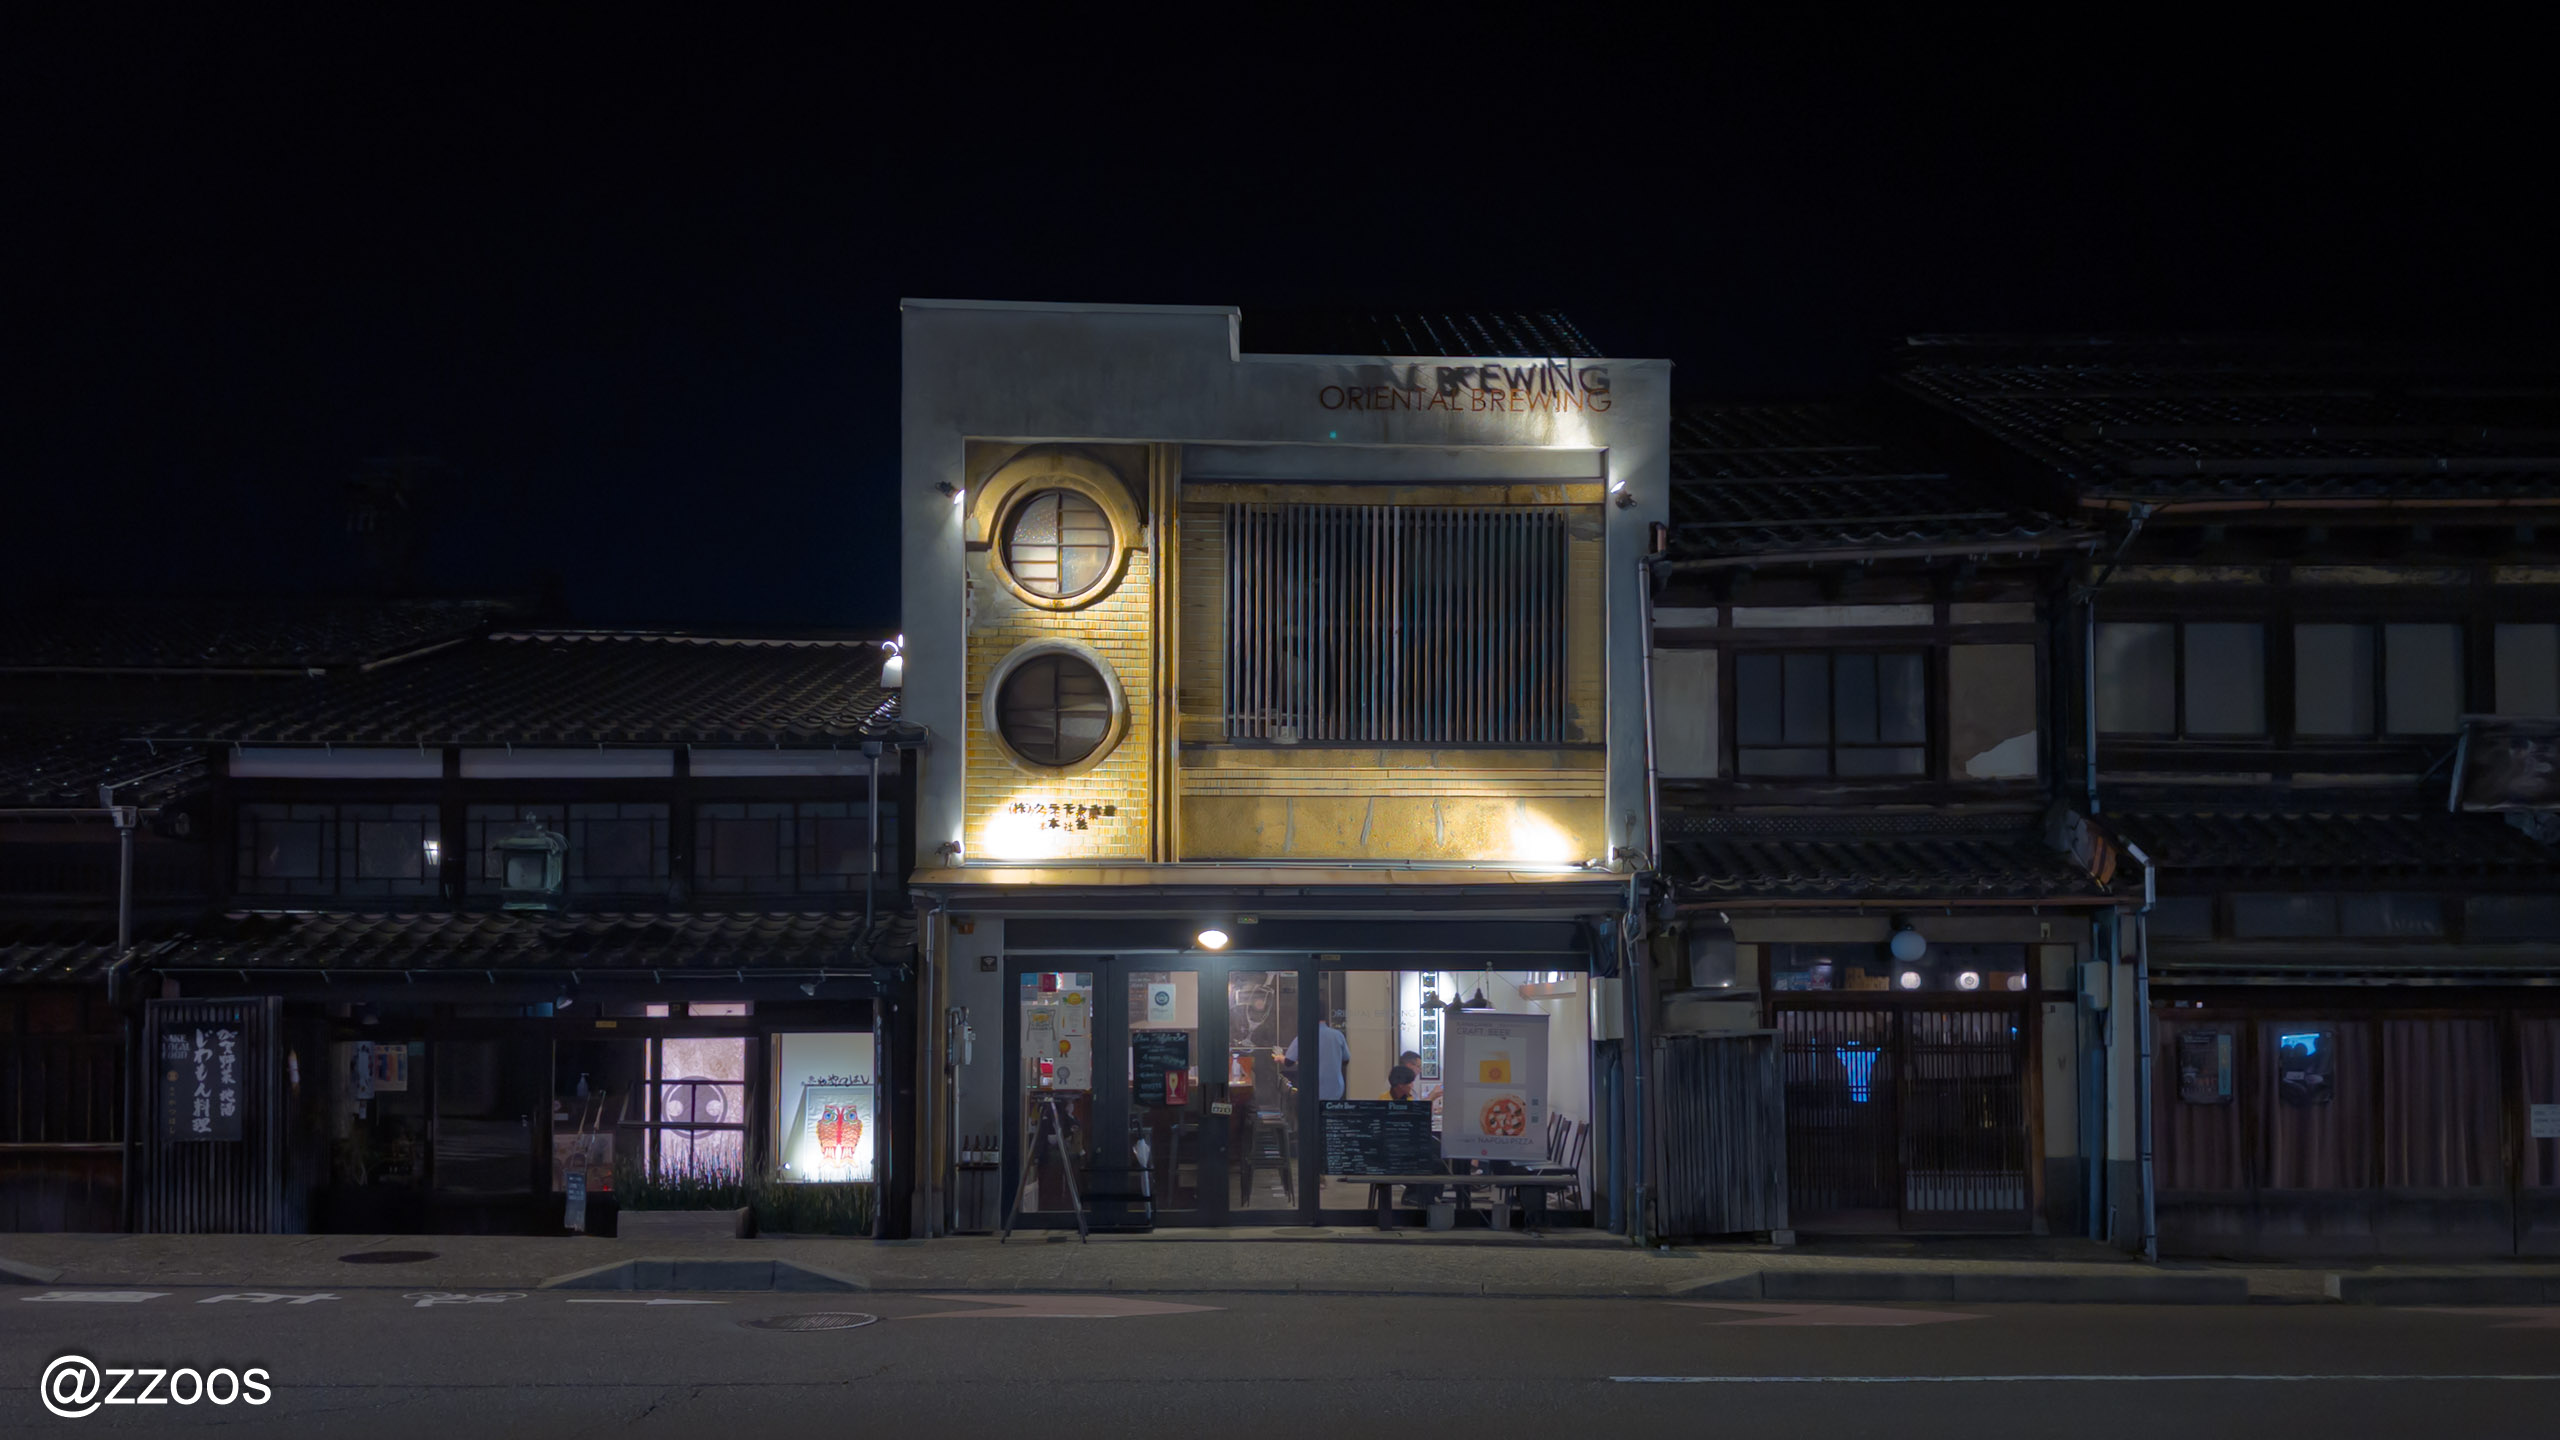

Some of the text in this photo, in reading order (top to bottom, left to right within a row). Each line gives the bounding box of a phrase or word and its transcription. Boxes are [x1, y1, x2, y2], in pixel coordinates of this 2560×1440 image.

[1319, 385, 1612, 412] ORIENTAL BREWING
[1456, 1027, 1484, 1036] CRAFT
[191, 1027, 213, 1133] じわもん料理
